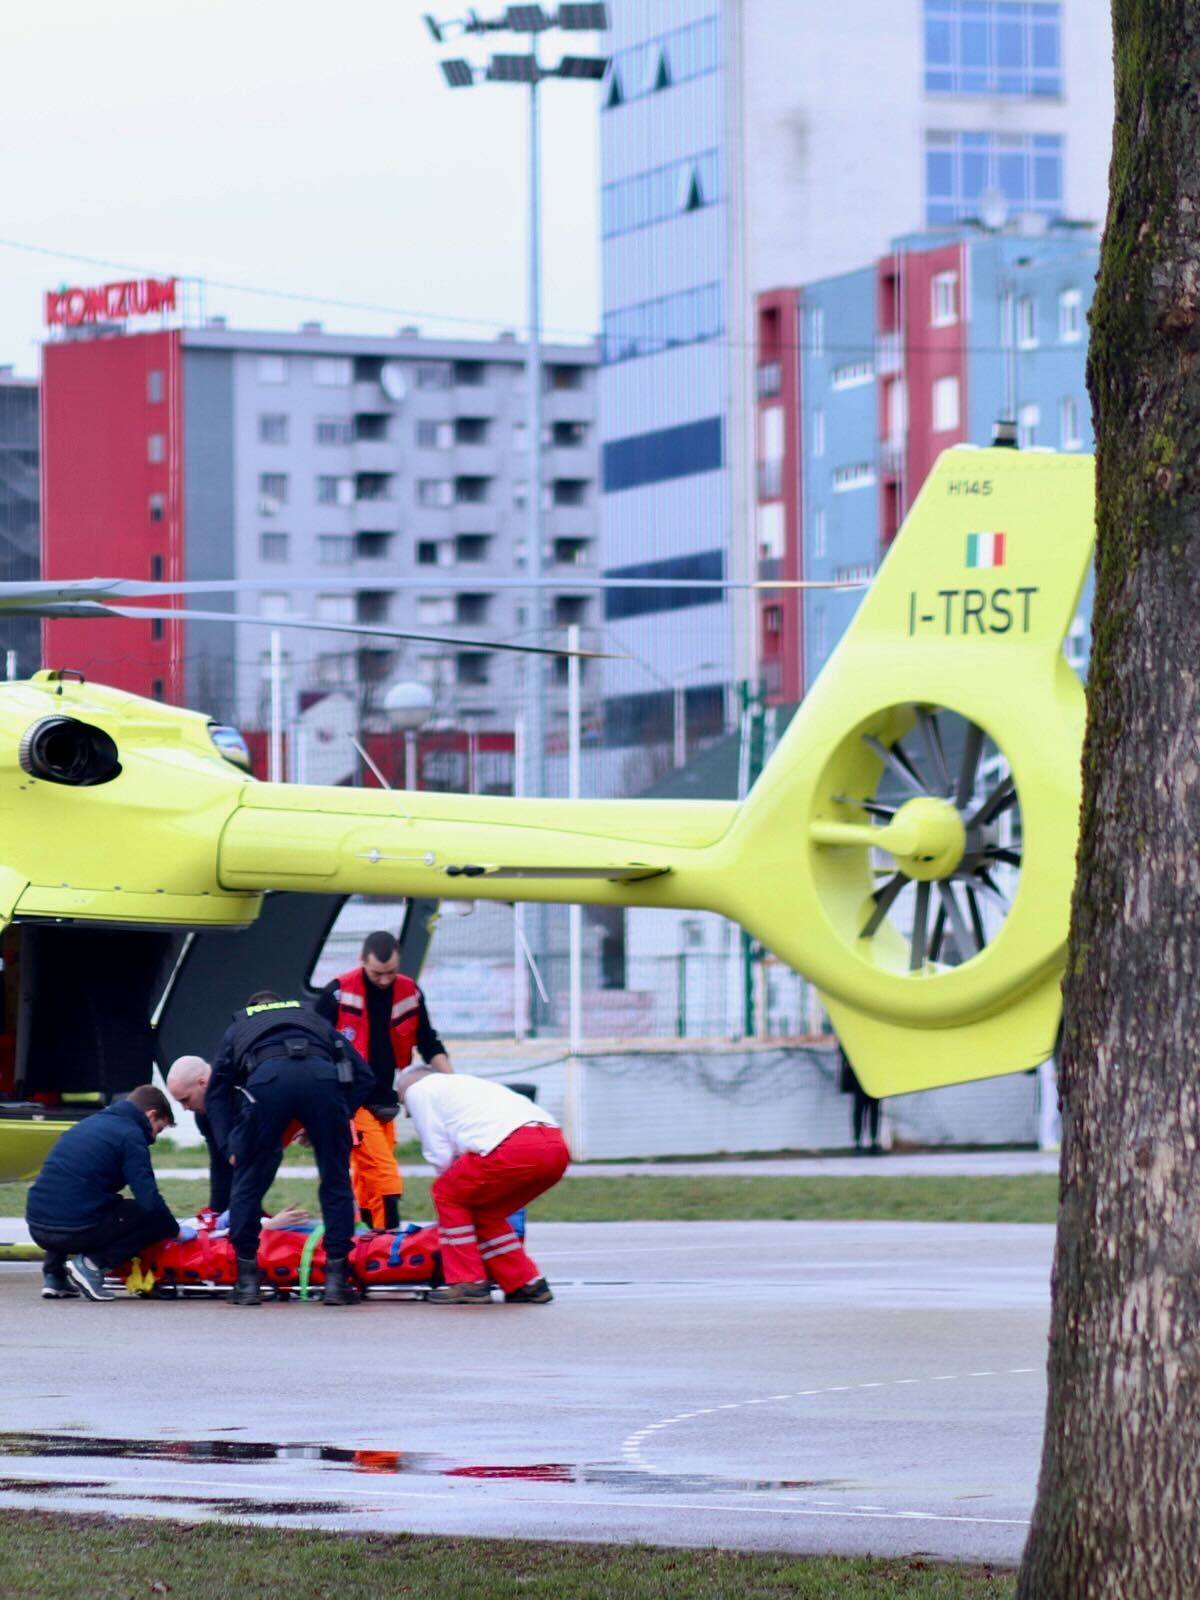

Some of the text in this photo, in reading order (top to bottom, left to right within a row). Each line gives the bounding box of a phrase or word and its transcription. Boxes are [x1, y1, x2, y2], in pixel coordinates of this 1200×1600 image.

[47, 278, 176, 326] KONZUM
[947, 480, 993, 496] H145
[908, 587, 1038, 637] I-TRST
